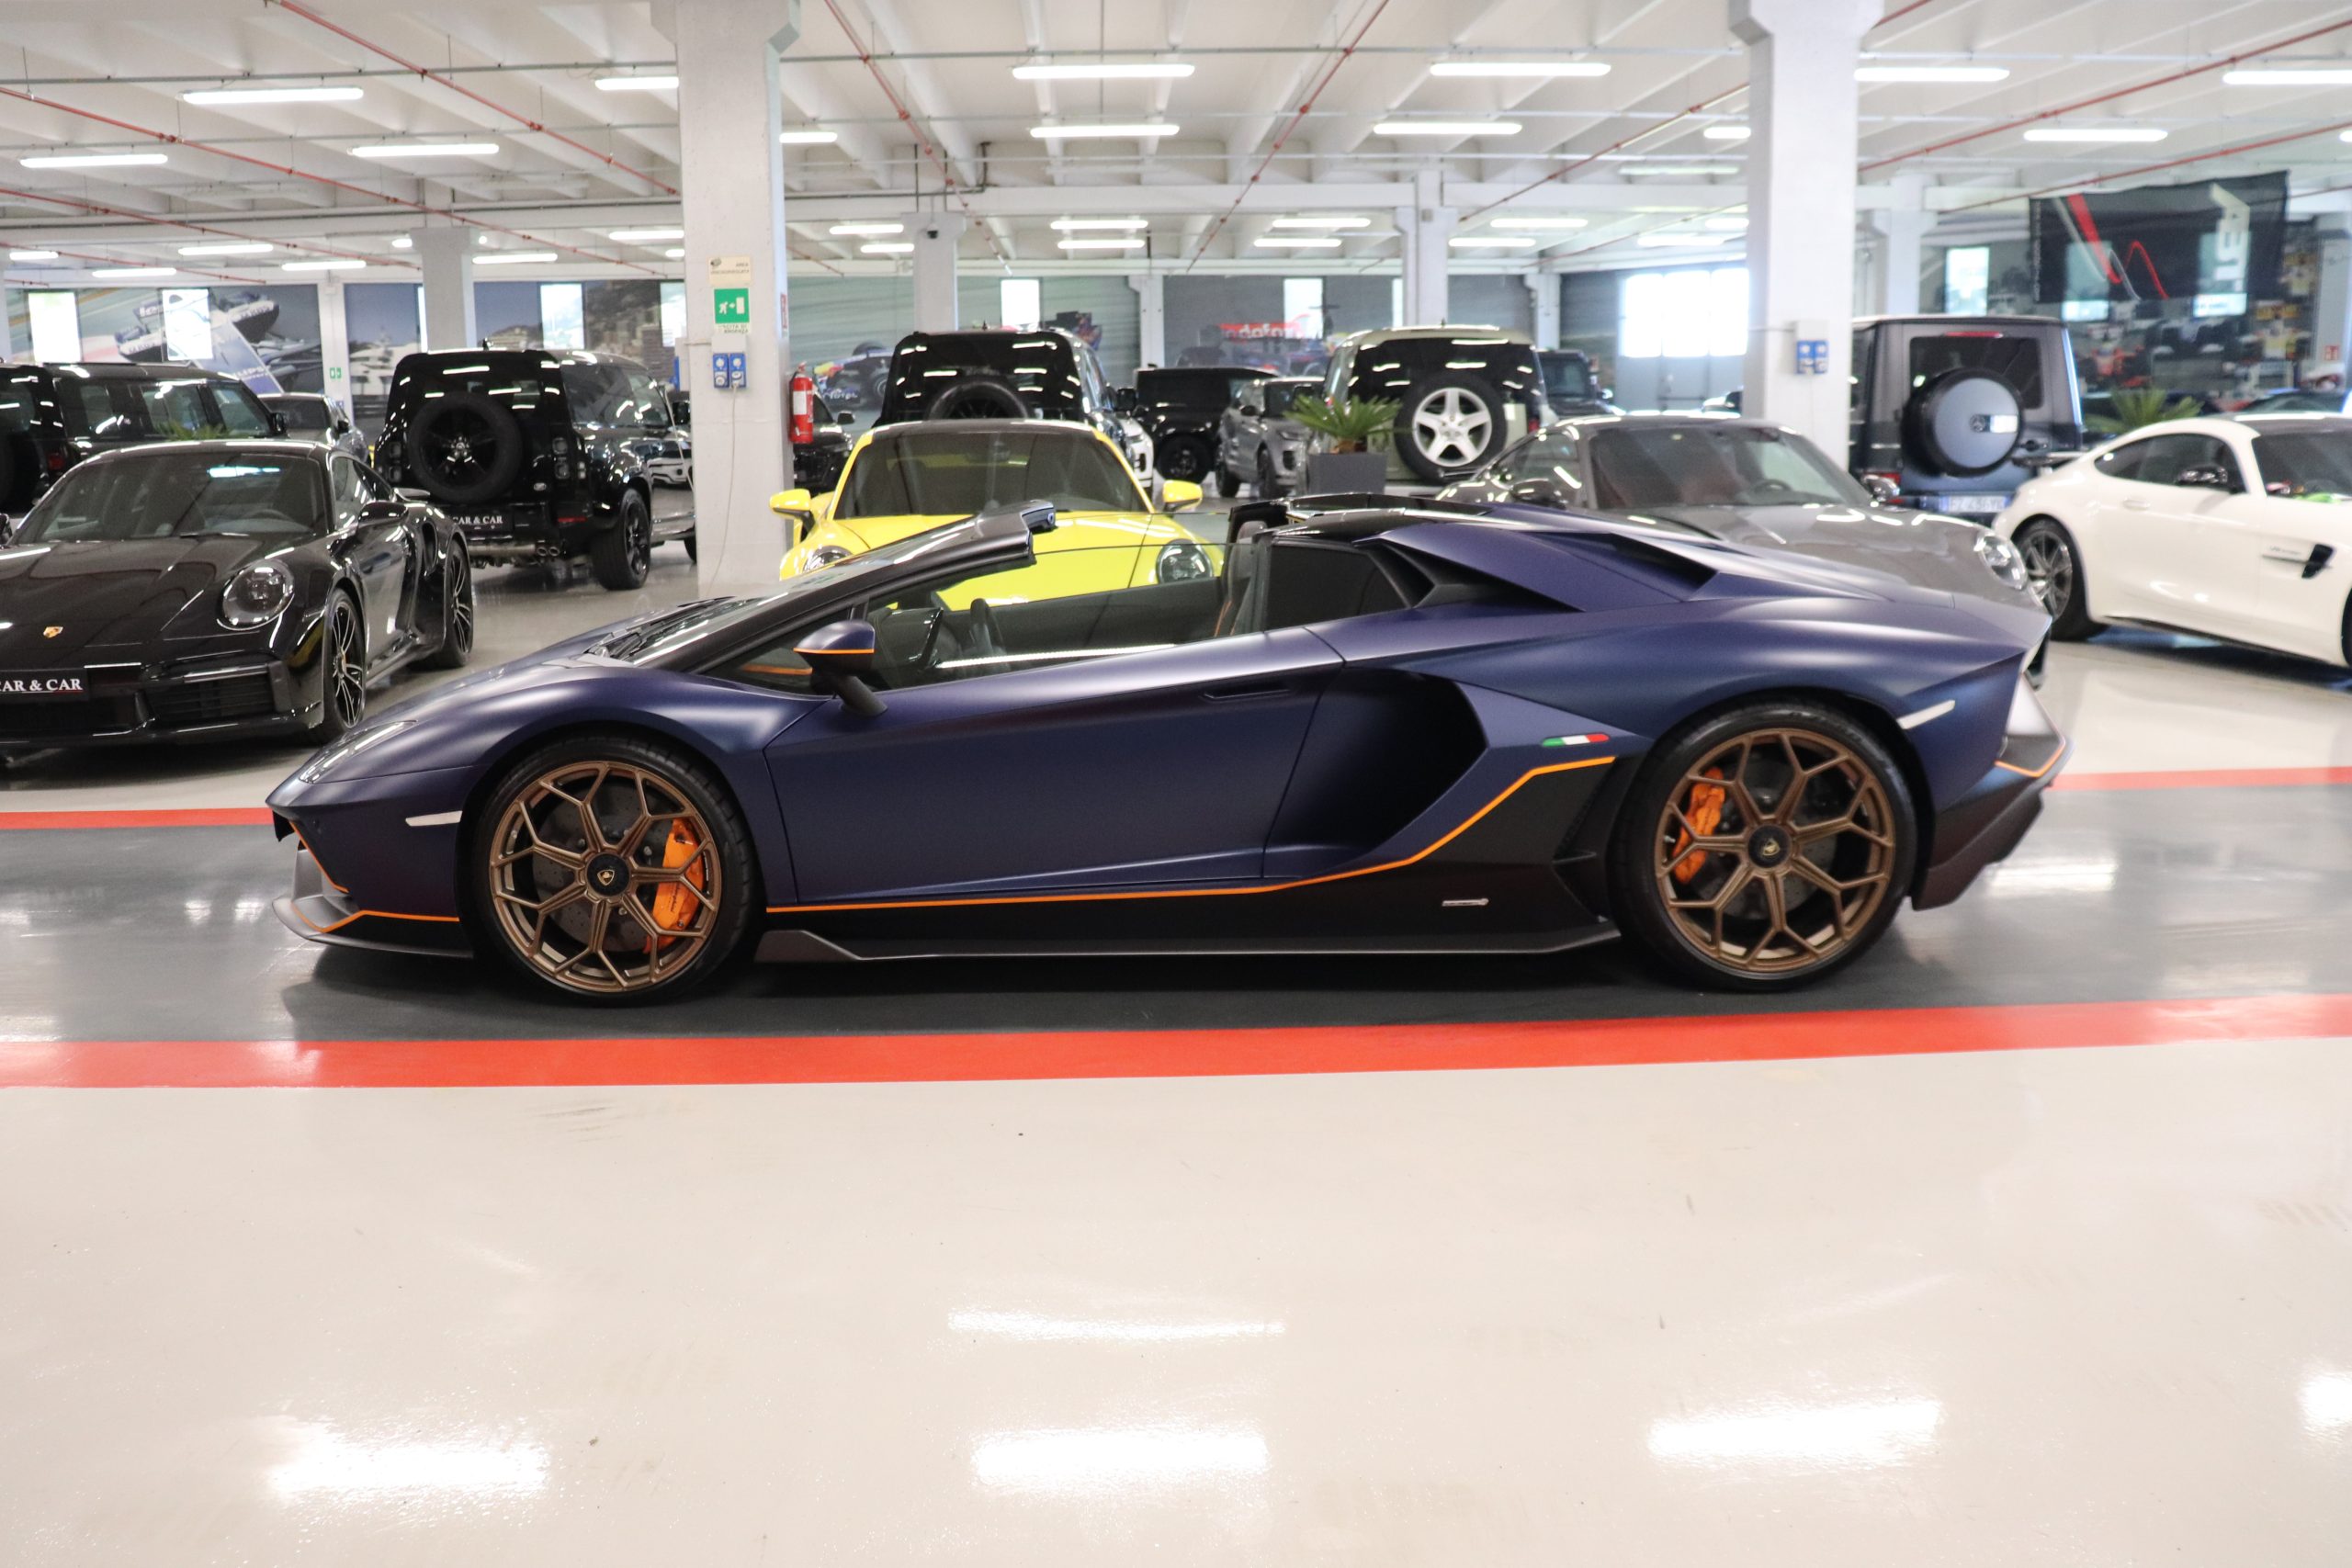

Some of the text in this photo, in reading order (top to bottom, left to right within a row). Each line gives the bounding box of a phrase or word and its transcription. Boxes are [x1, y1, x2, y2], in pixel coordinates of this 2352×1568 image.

[2210, 183, 2250, 291] ABT
[482, 515, 503, 525] CAR
[0, 678, 83, 692] AR & CAR
